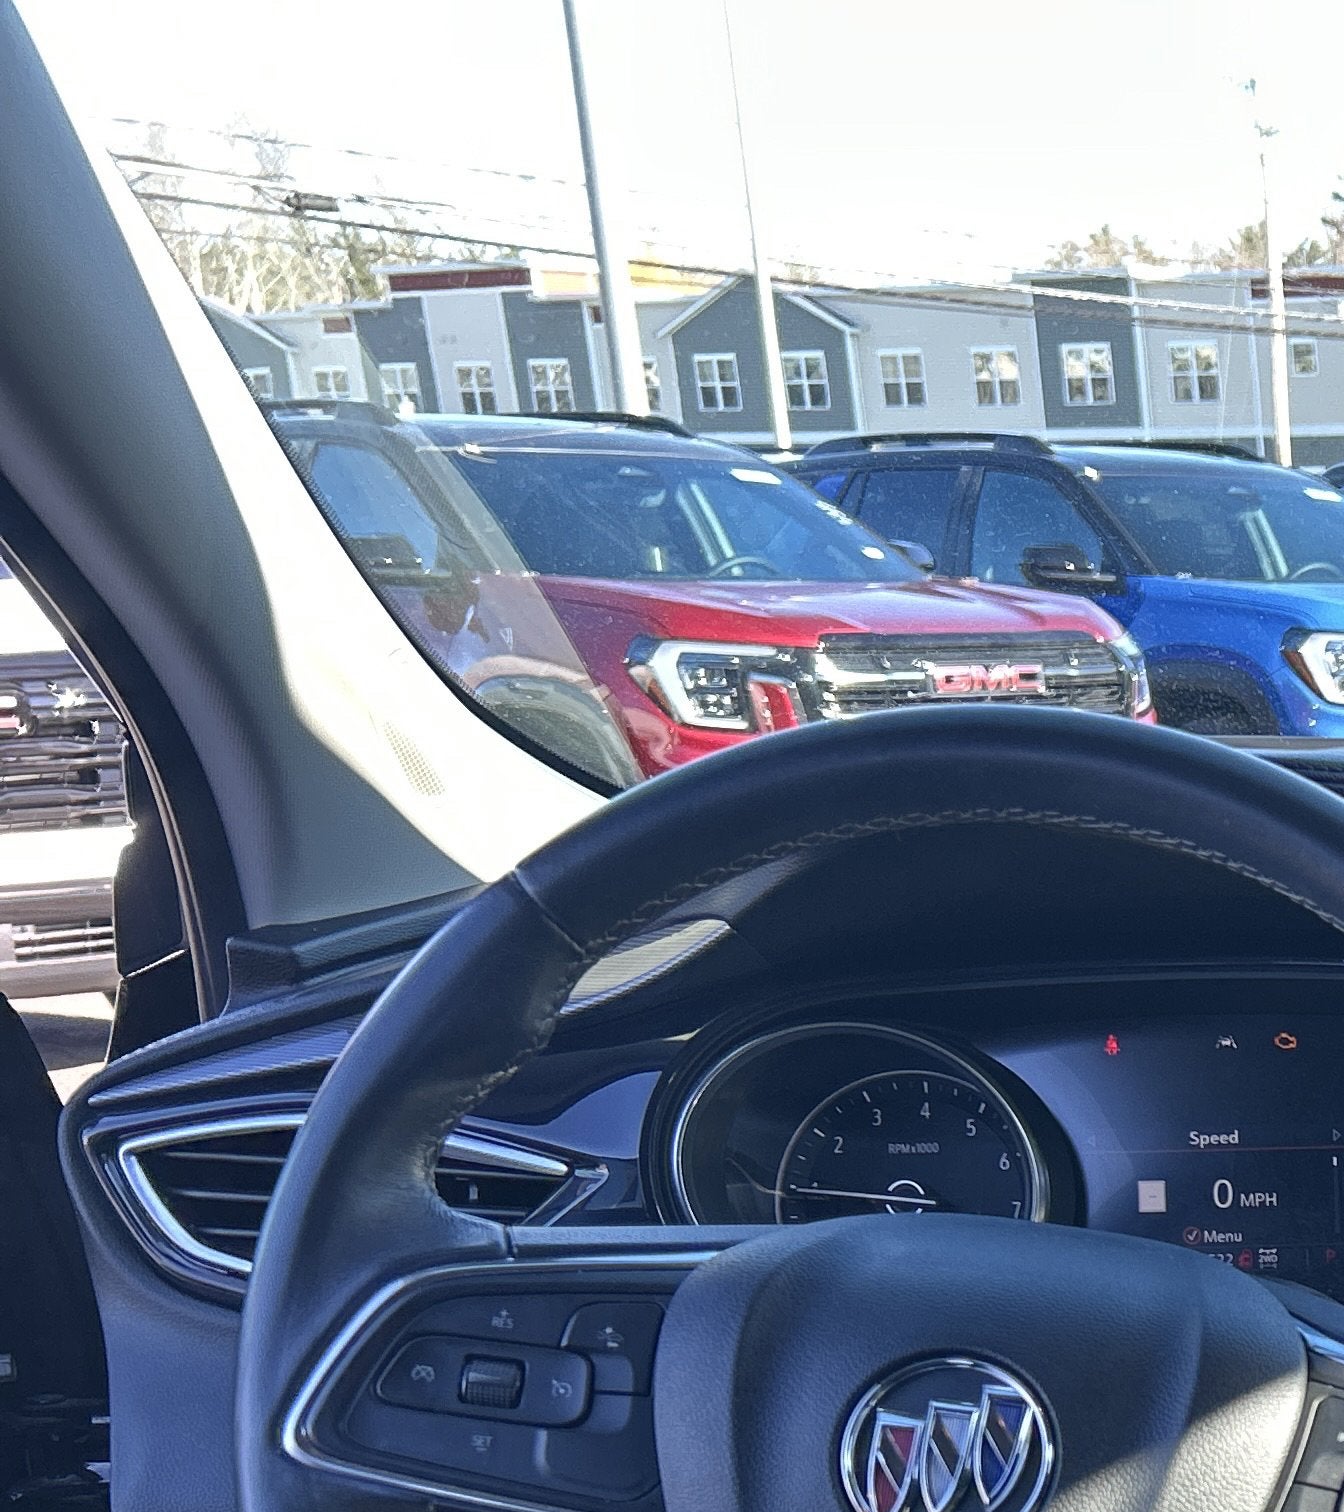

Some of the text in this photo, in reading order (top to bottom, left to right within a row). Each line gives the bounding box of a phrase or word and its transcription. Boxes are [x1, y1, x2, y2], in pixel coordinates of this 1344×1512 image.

[933, 663, 1045, 694] GMC
[871, 1108, 882, 1127] 3
[920, 1101, 931, 1120] 4
[965, 1119, 977, 1138] 5
[833, 1136, 844, 1155] 2
[1189, 1129, 1239, 1149] Speed
[1000, 1152, 1010, 1171] 6
[1213, 1178, 1278, 1209] 0 MPH
[1203, 1230, 1243, 1244] Menu
[491, 1317, 513, 1330] RES
[472, 1434, 493, 1447] SET
